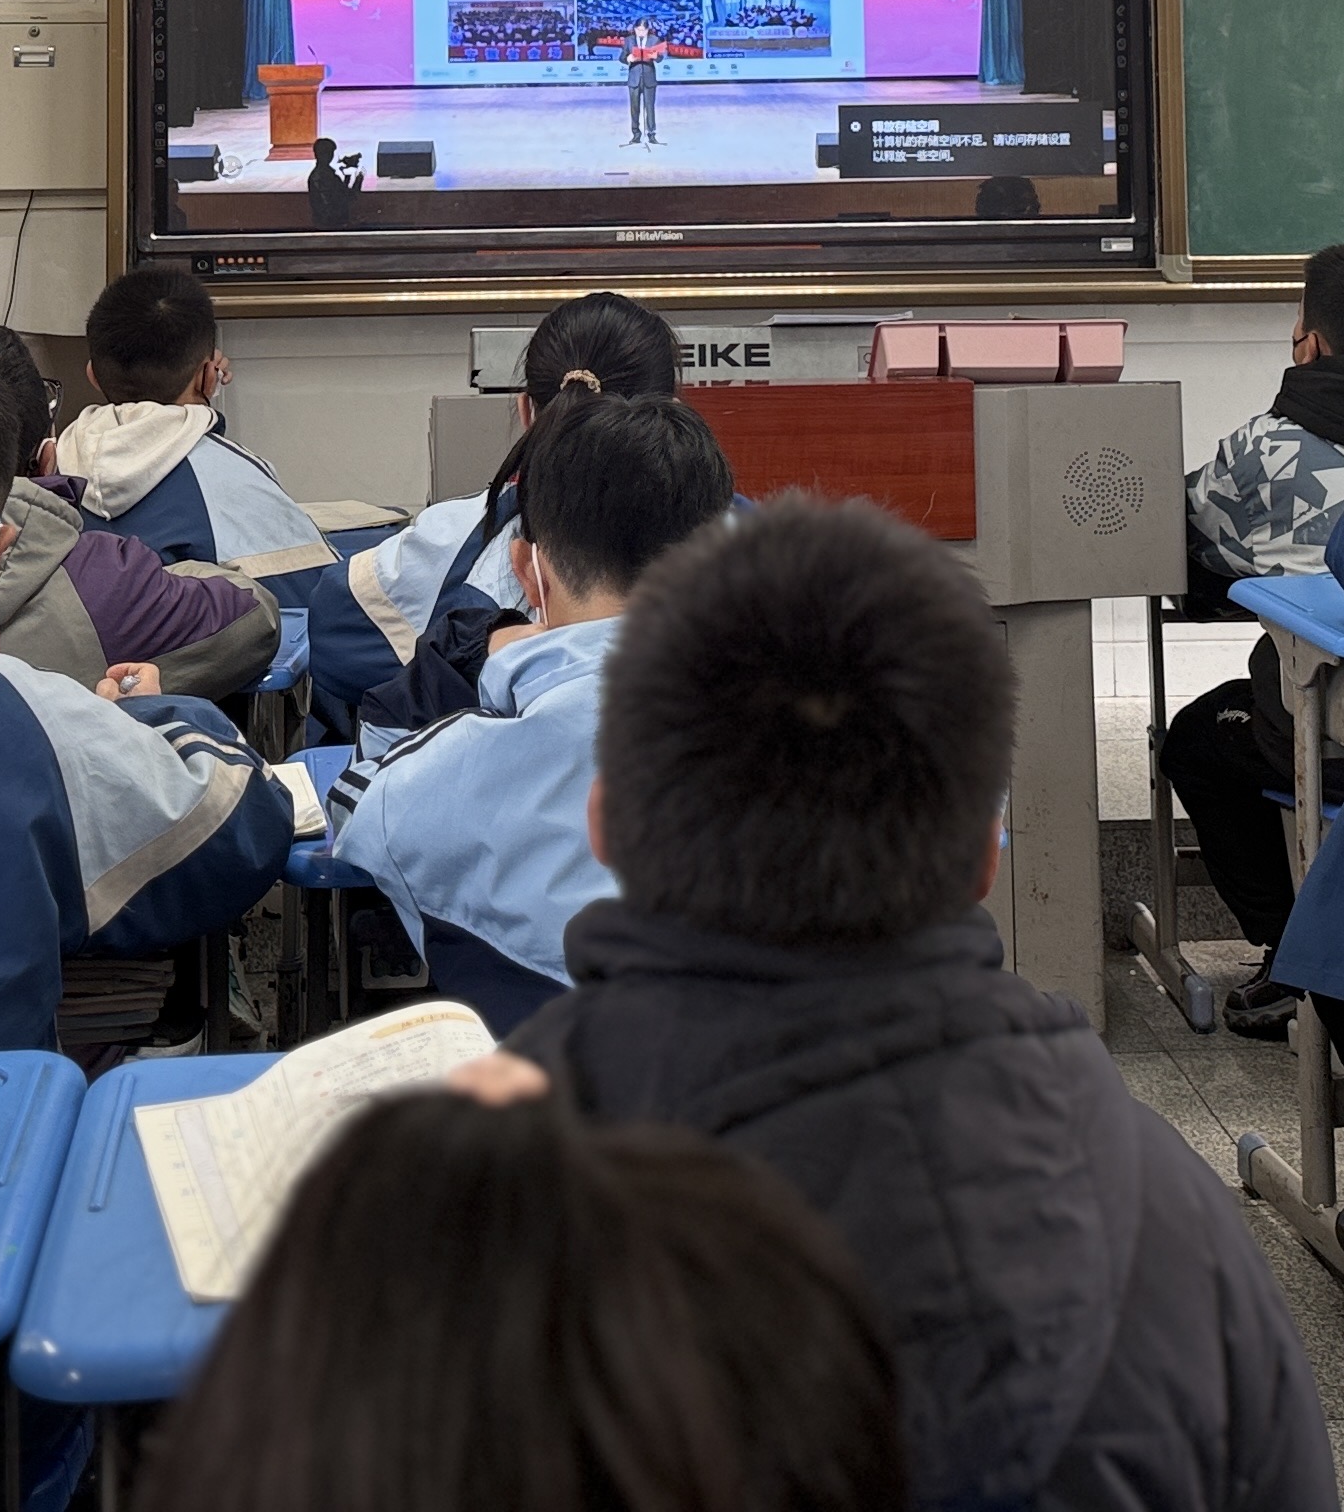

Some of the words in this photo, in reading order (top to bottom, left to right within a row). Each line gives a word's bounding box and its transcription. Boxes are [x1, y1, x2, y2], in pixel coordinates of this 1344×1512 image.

[871, 119, 940, 133] 释放存储空间
[872, 133, 1071, 148] 计算机的存储空间不足。请访问存储设置
[872, 149, 955, 163] 以释放一些空间。
[635, 230, 684, 241] HiteVision
